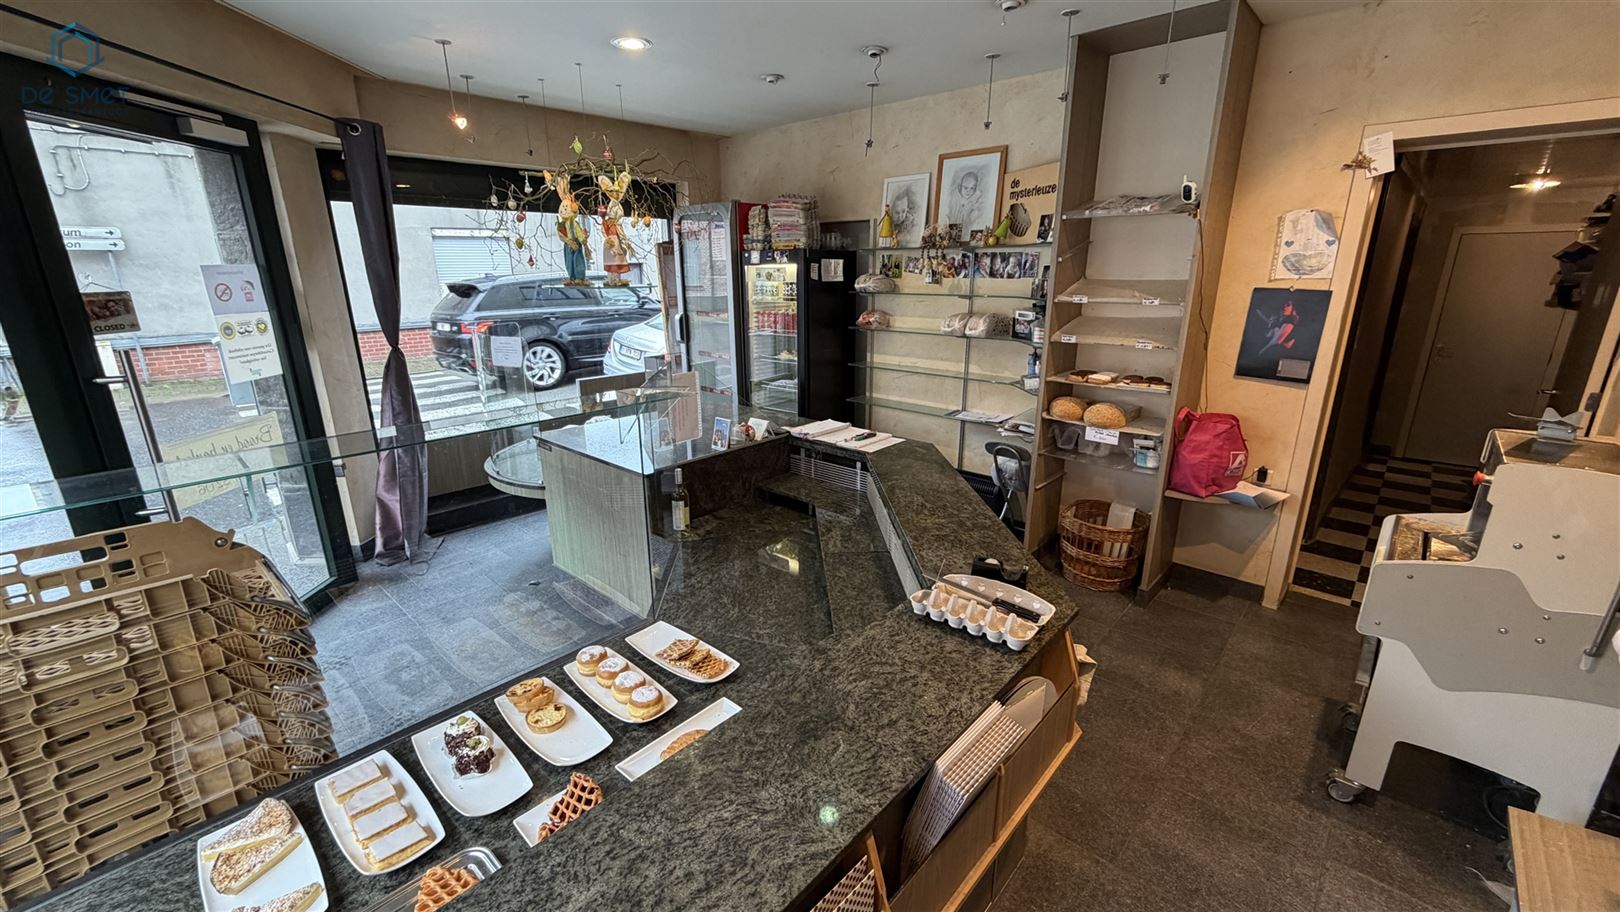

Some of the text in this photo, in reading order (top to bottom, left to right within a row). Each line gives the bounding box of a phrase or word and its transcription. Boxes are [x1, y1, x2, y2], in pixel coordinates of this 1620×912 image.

[1010, 178, 1020, 189] de
[1009, 184, 1057, 201] mysterieuze
[63, 229, 82, 237] um
[94, 323, 126, 332] CLOSED
